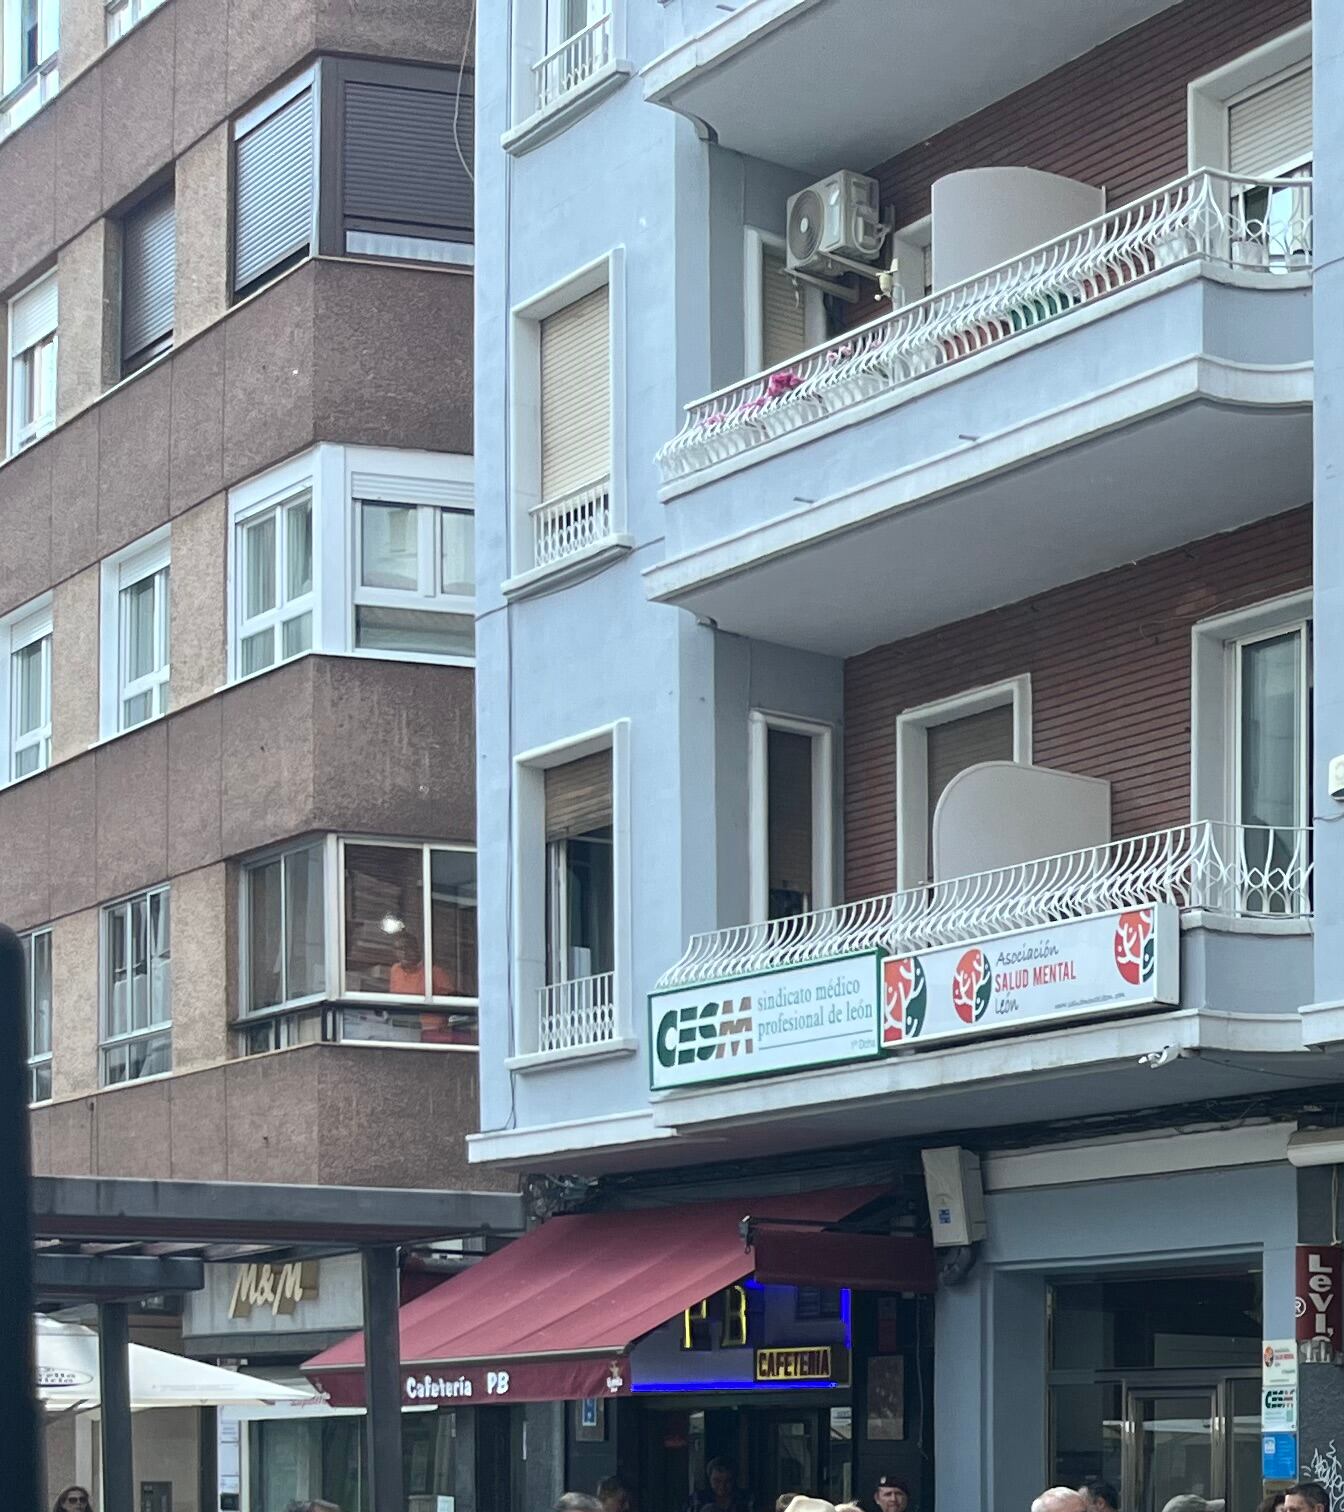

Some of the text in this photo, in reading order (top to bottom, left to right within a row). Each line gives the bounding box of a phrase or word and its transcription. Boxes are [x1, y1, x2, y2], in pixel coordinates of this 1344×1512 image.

[996, 939, 1059, 967] Asociación
[995, 960, 1077, 993] SALUD MENTAL
[757, 976, 860, 1011] sindicato médico
[656, 996, 753, 1068] CESM
[758, 998, 873, 1041] profesional de león
[758, 1350, 831, 1378] CAFETERIA
[406, 1371, 510, 1399] Cafetería PB
